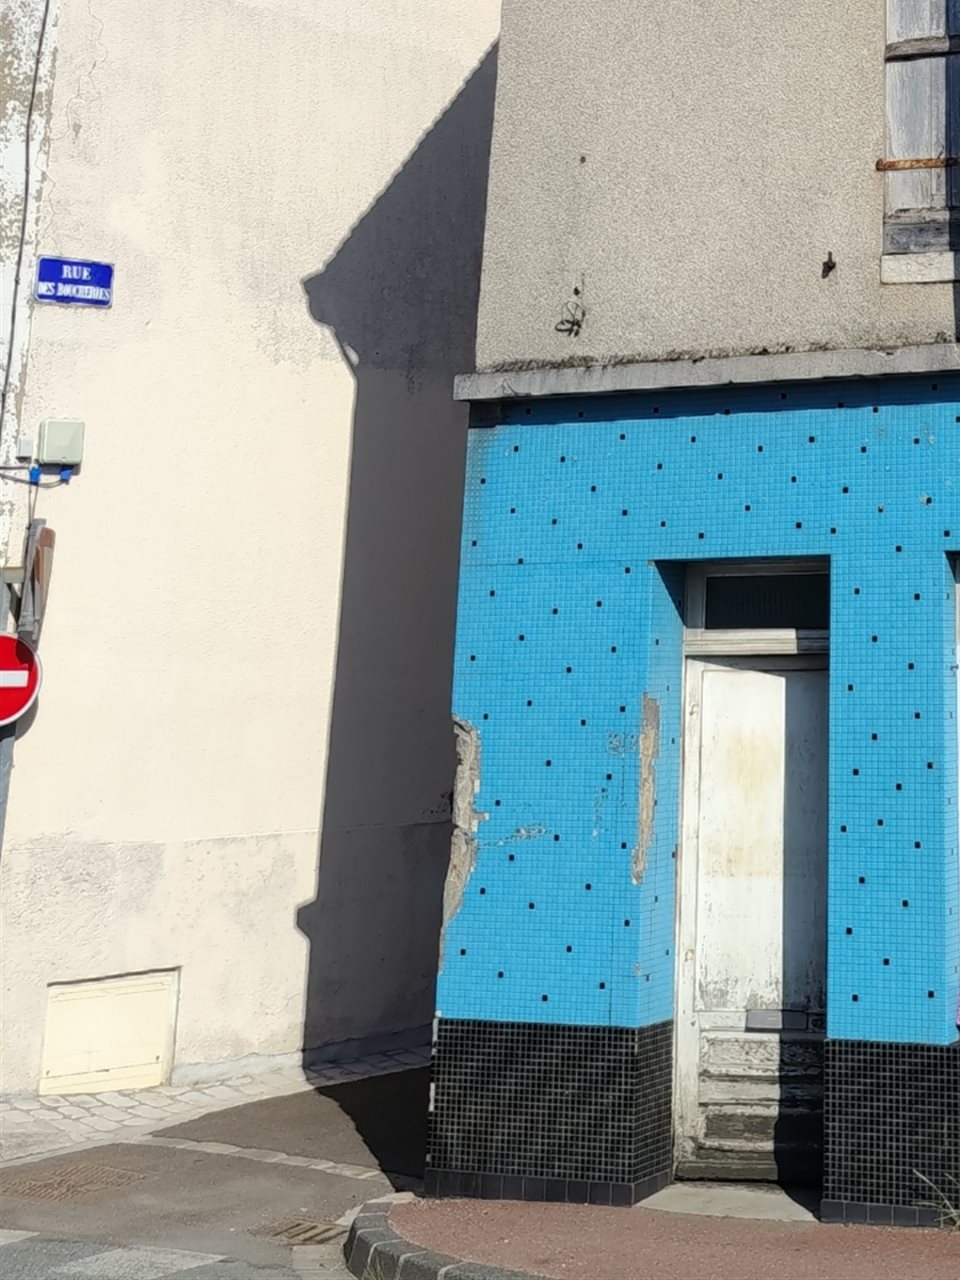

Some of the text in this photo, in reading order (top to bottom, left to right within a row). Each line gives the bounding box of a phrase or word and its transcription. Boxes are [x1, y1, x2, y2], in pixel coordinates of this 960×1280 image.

[61, 264, 92, 280] RUE
[38, 281, 110, 300] DES BOUCHERIES
